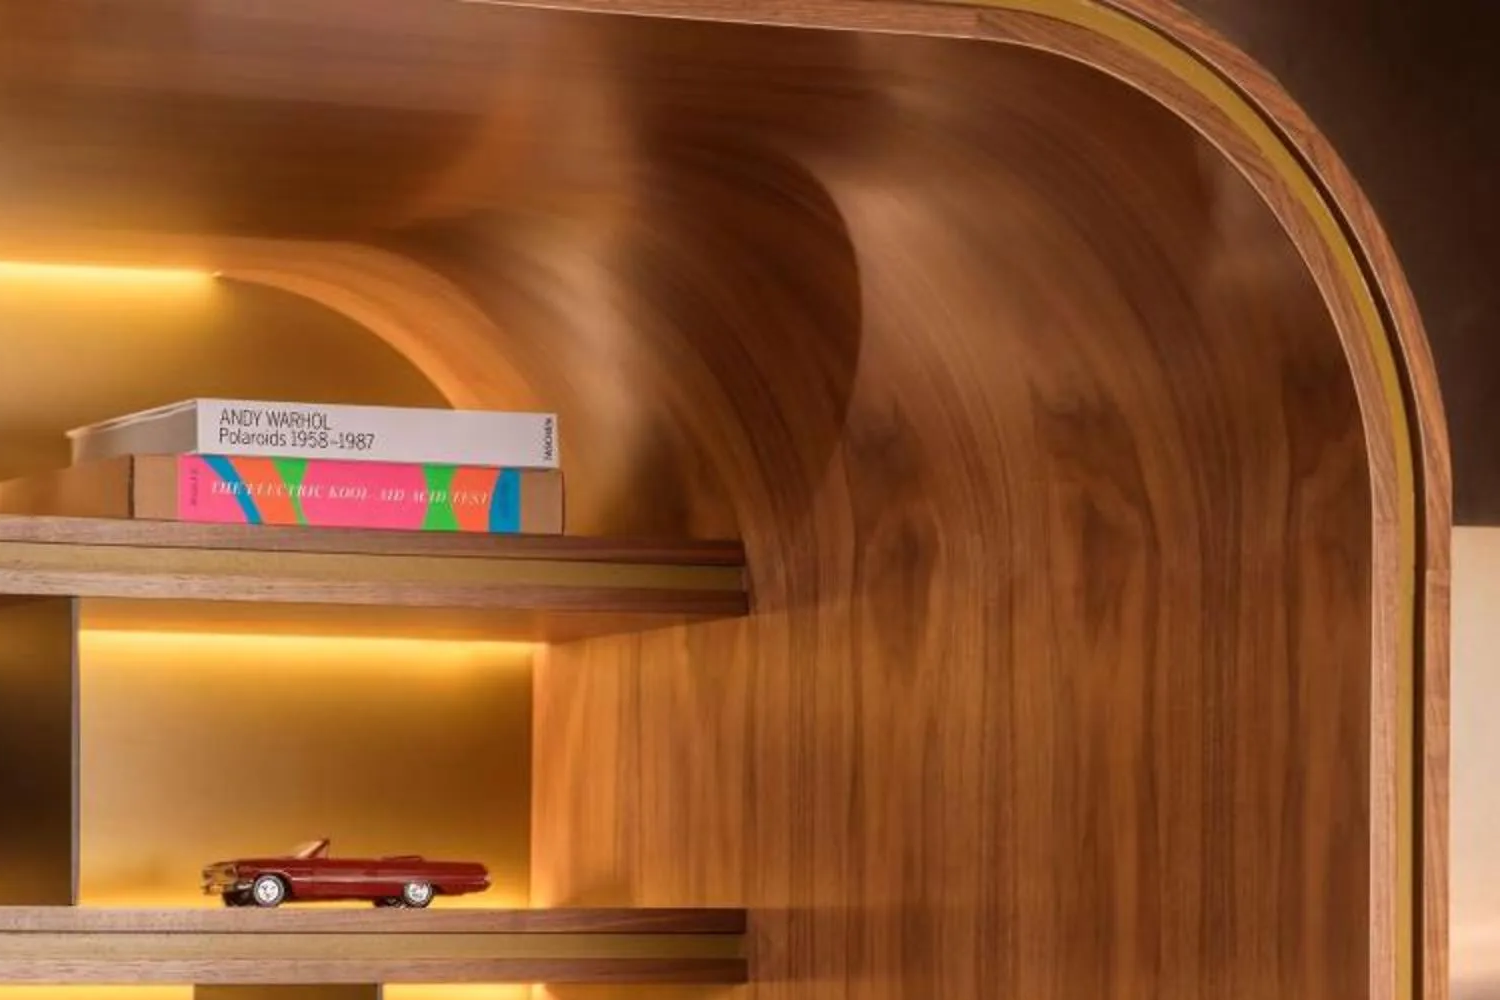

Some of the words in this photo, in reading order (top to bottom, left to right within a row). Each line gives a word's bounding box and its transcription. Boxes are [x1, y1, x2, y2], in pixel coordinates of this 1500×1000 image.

[219, 408, 262, 428] ANDY
[265, 410, 333, 431] WARHOL
[219, 427, 287, 447] Polaroids
